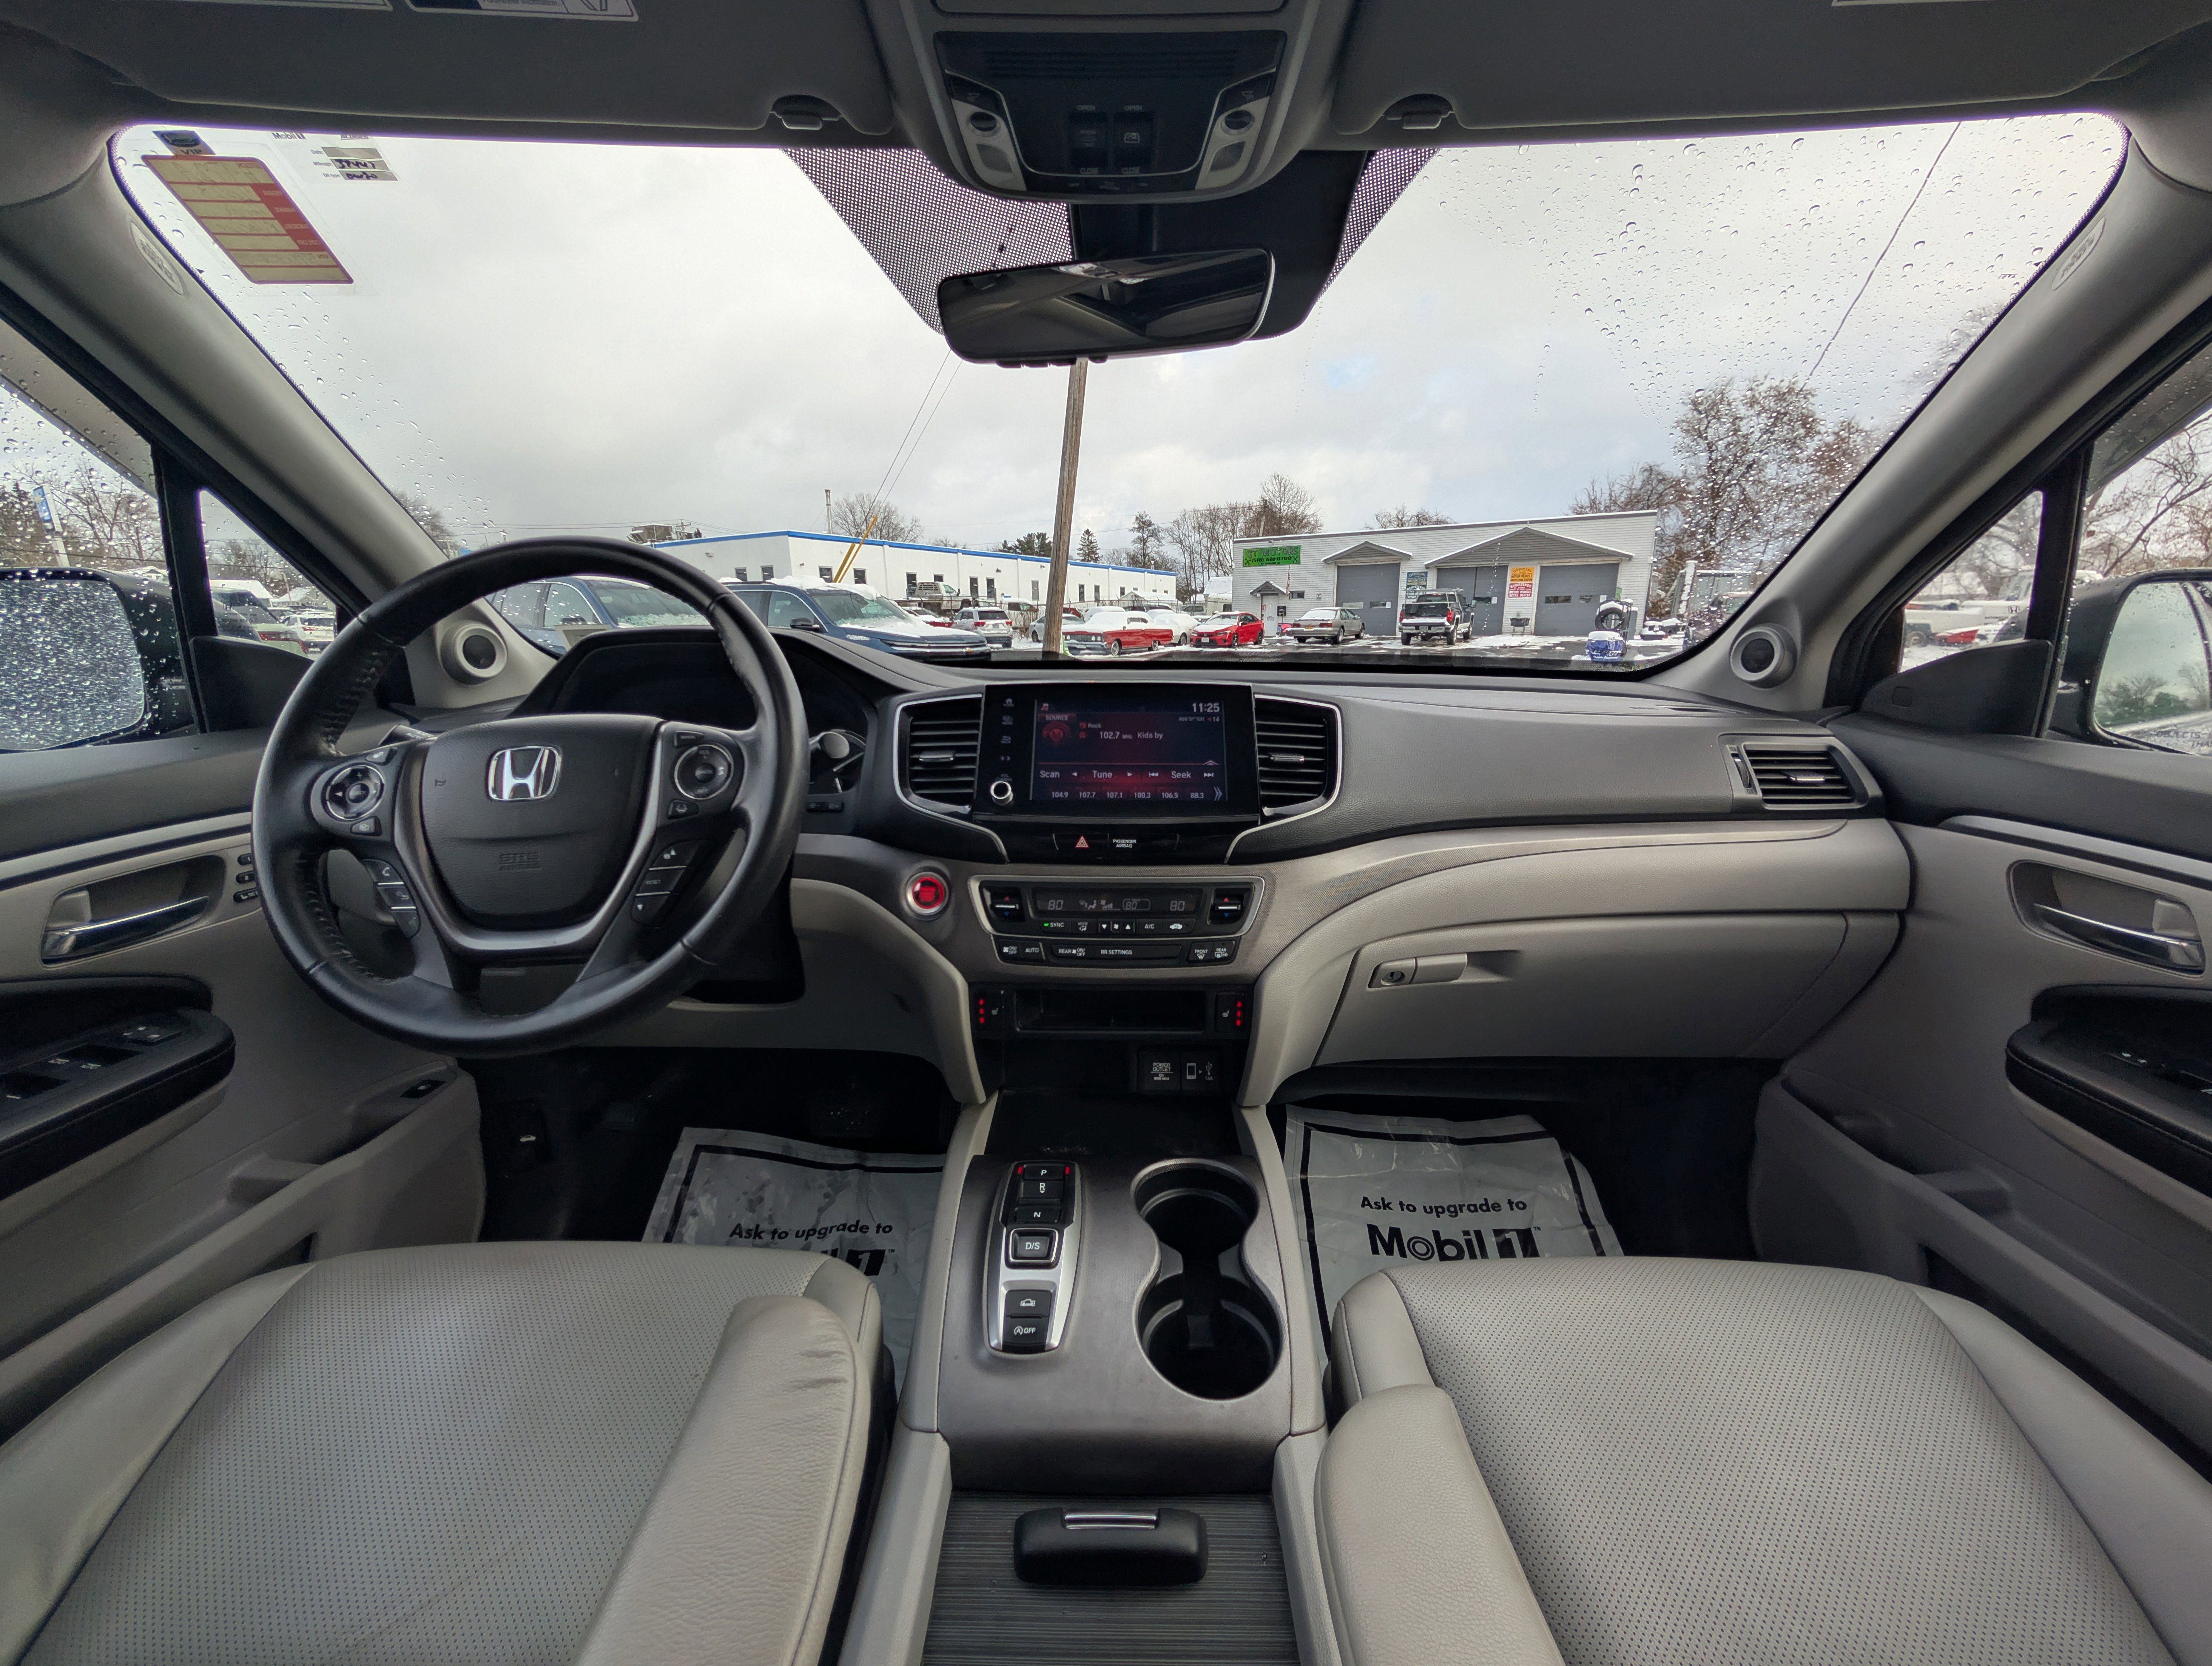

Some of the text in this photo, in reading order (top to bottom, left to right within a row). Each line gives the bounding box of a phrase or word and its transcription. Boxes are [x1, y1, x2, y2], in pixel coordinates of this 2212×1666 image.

[1247, 547, 1299, 558] GT MOTORS
[1192, 703, 1220, 713] 11:25
[1154, 732, 1163, 740] by
[1048, 900, 1063, 910] 80
[1125, 902, 1137, 910] 80
[1170, 900, 1185, 911] 80
[1361, 1196, 1527, 1218] Ask to upgrade to
[729, 1219, 893, 1241] Ask to upgrade to
[1025, 1242, 1040, 1250] D/S
[1366, 1223, 1489, 1261] Mobil
[1492, 1227, 1540, 1258] 1
[845, 1249, 886, 1276] 1
